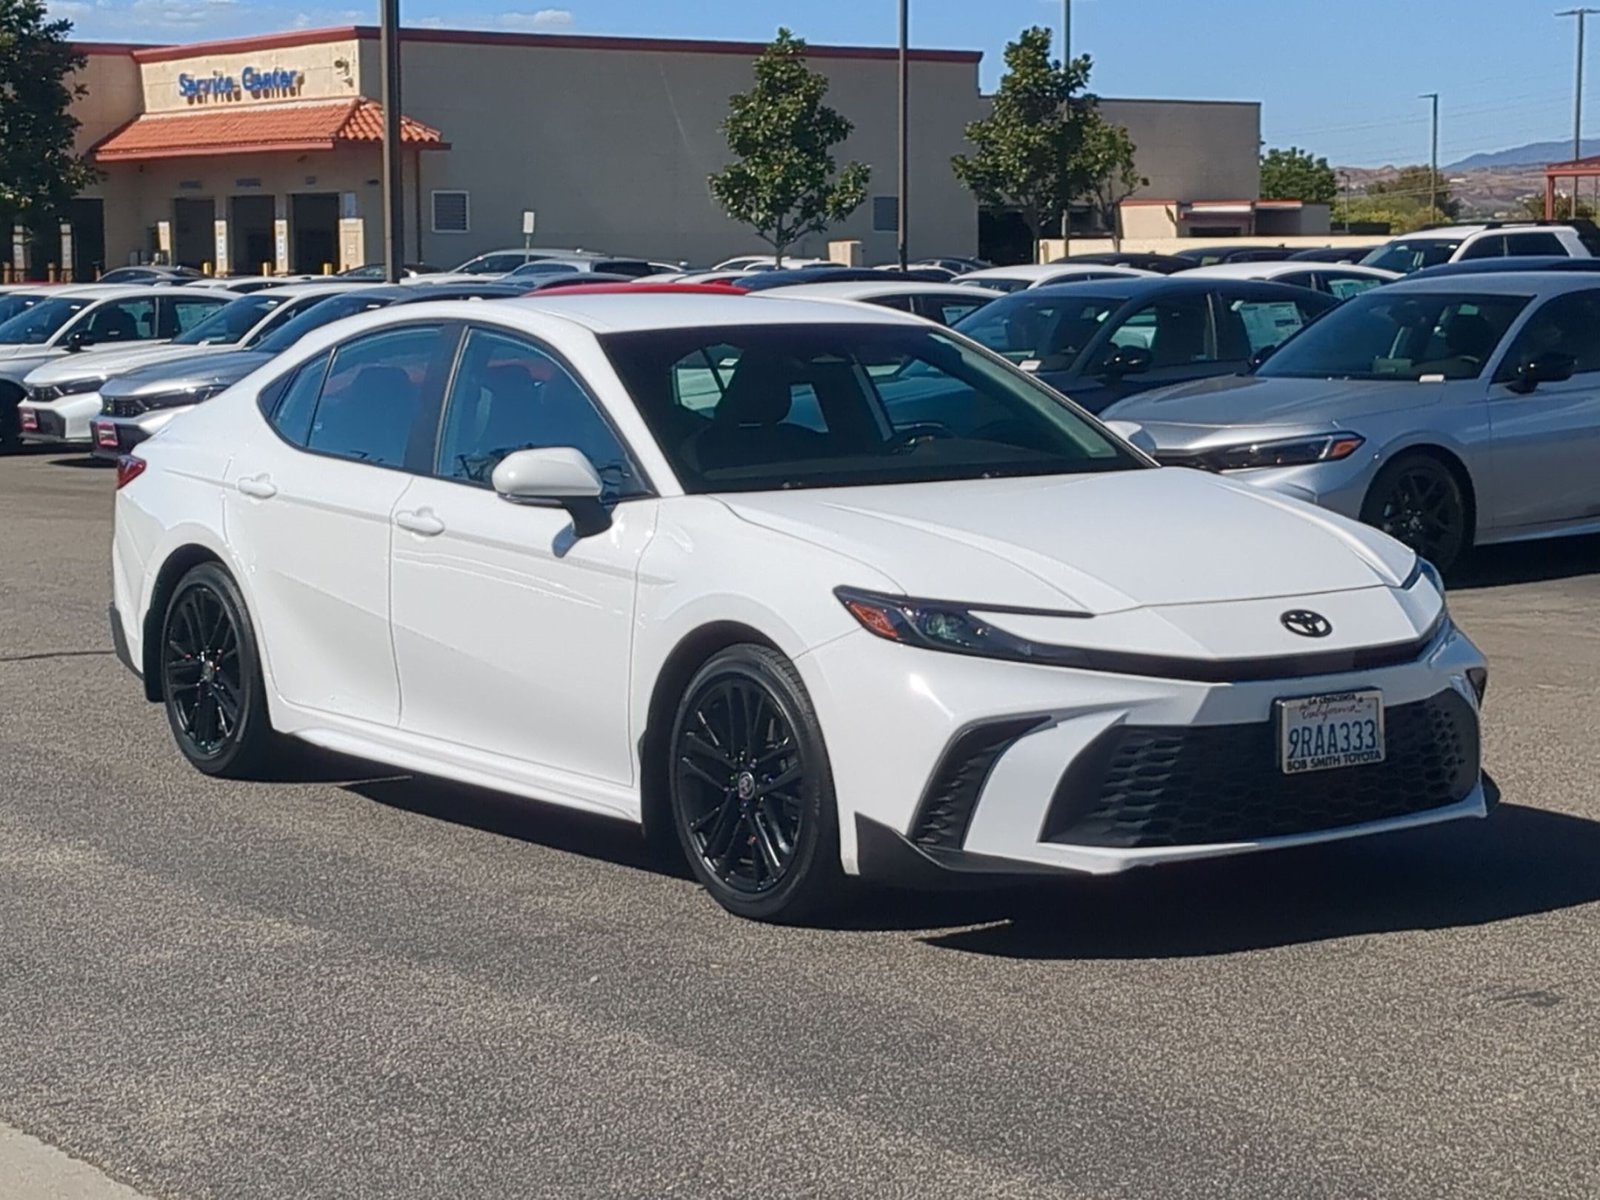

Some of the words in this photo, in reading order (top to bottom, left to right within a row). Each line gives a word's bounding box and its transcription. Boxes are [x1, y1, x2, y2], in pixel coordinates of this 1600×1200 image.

[179, 70, 236, 98] Service
[242, 66, 300, 94] Center
[1288, 719, 1377, 759] 9RAA333
[1287, 760, 1307, 771] BOB
[1310, 755, 1341, 768] SMITH
[1344, 750, 1382, 764] TOYOTA
